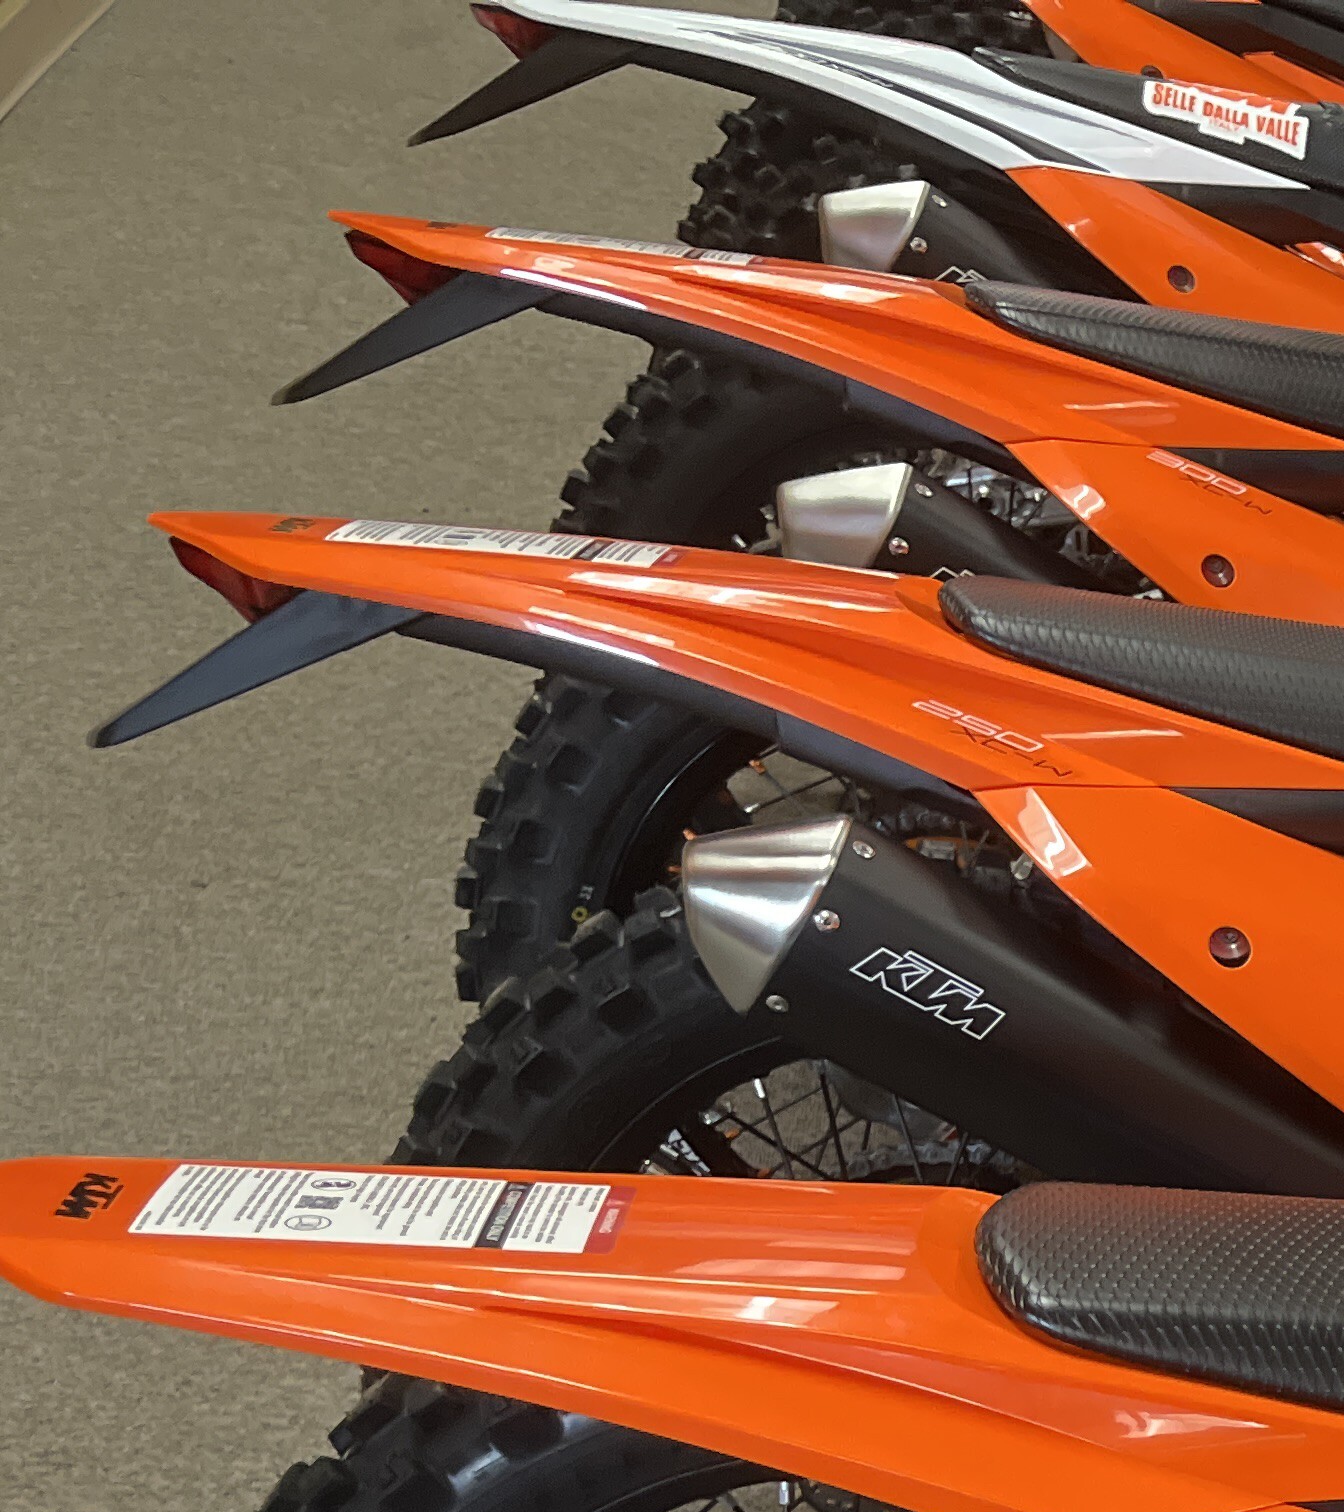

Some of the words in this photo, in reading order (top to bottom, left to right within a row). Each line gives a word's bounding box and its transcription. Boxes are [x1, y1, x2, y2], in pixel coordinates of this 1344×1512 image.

[1152, 82, 1198, 113] SELLE
[1202, 101, 1249, 129] DALLA
[1256, 114, 1301, 146] VALLE
[1146, 450, 1247, 495] 300
[911, 699, 1045, 753] 250
[849, 947, 1006, 1040] KTM
